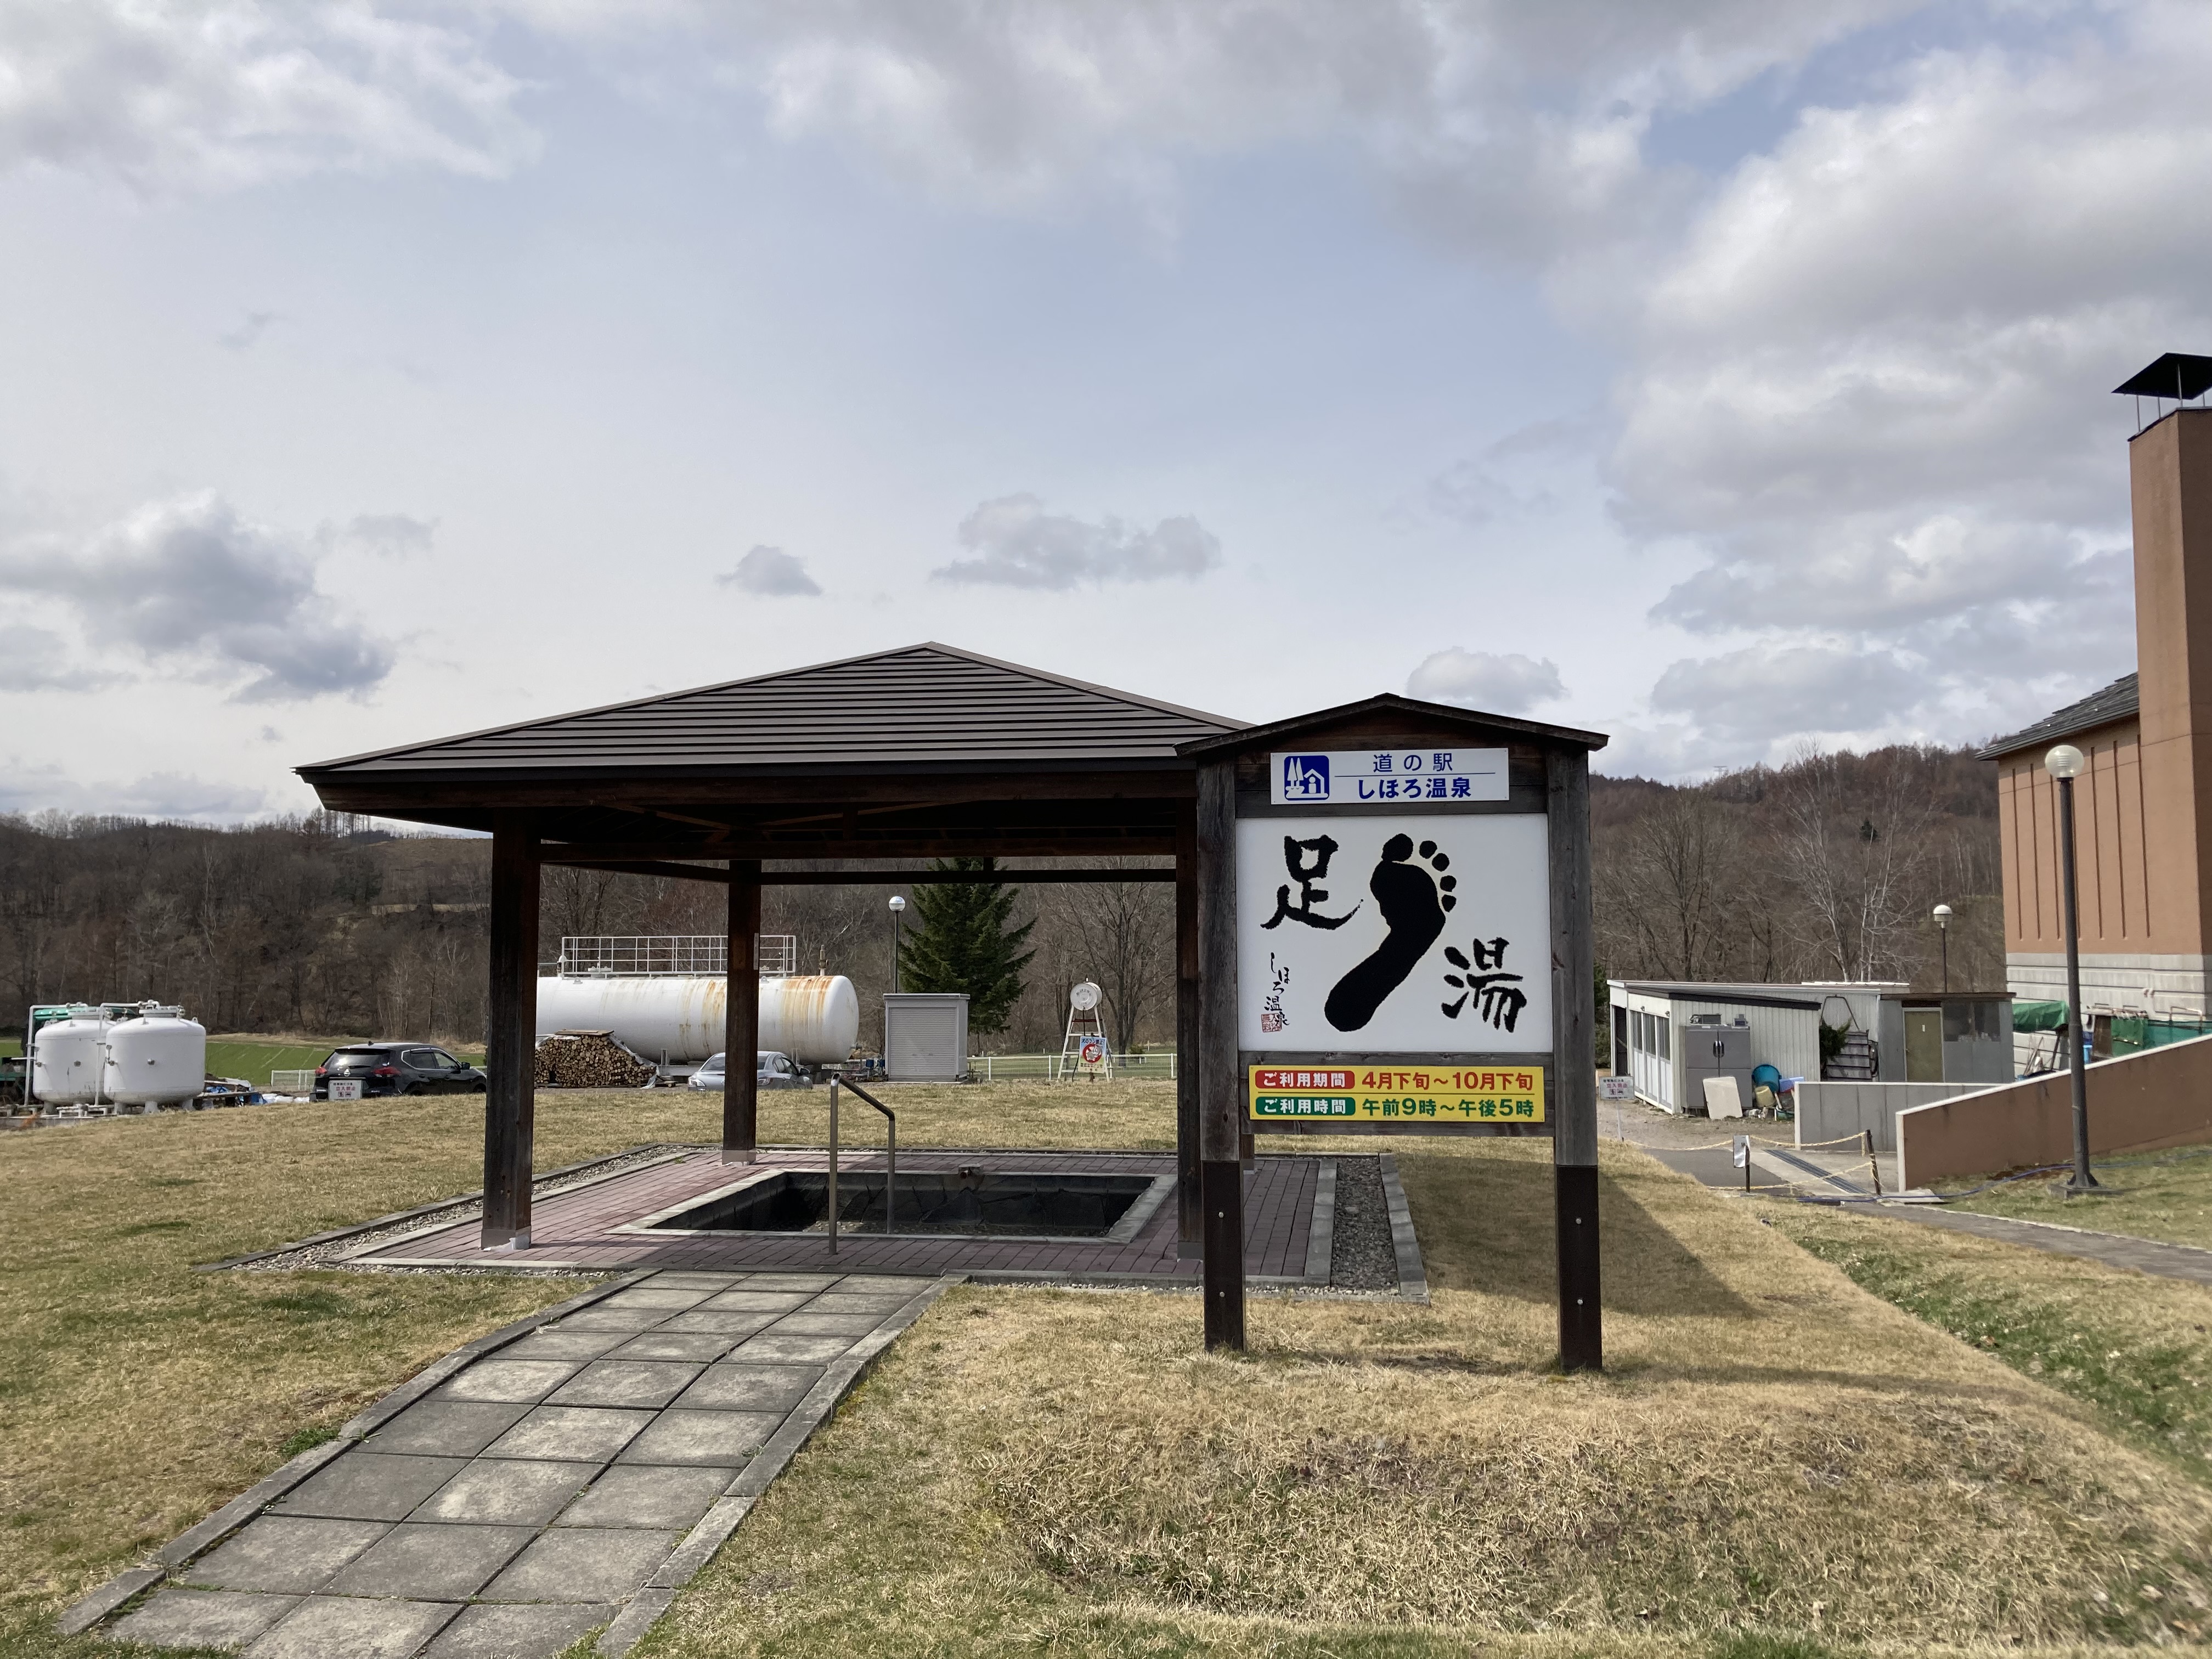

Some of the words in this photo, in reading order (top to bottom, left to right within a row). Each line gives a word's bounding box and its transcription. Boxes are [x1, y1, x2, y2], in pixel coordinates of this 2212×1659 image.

[1373, 753, 1453, 772] 道の駅
[1358, 777, 1471, 799] しほろ温泉
[1260, 834, 1364, 930] 足
[1441, 937, 1527, 1033] 湯
[1263, 1072, 1345, 1088] ご利用期間
[1263, 1098, 1346, 1114] ご利用時間
